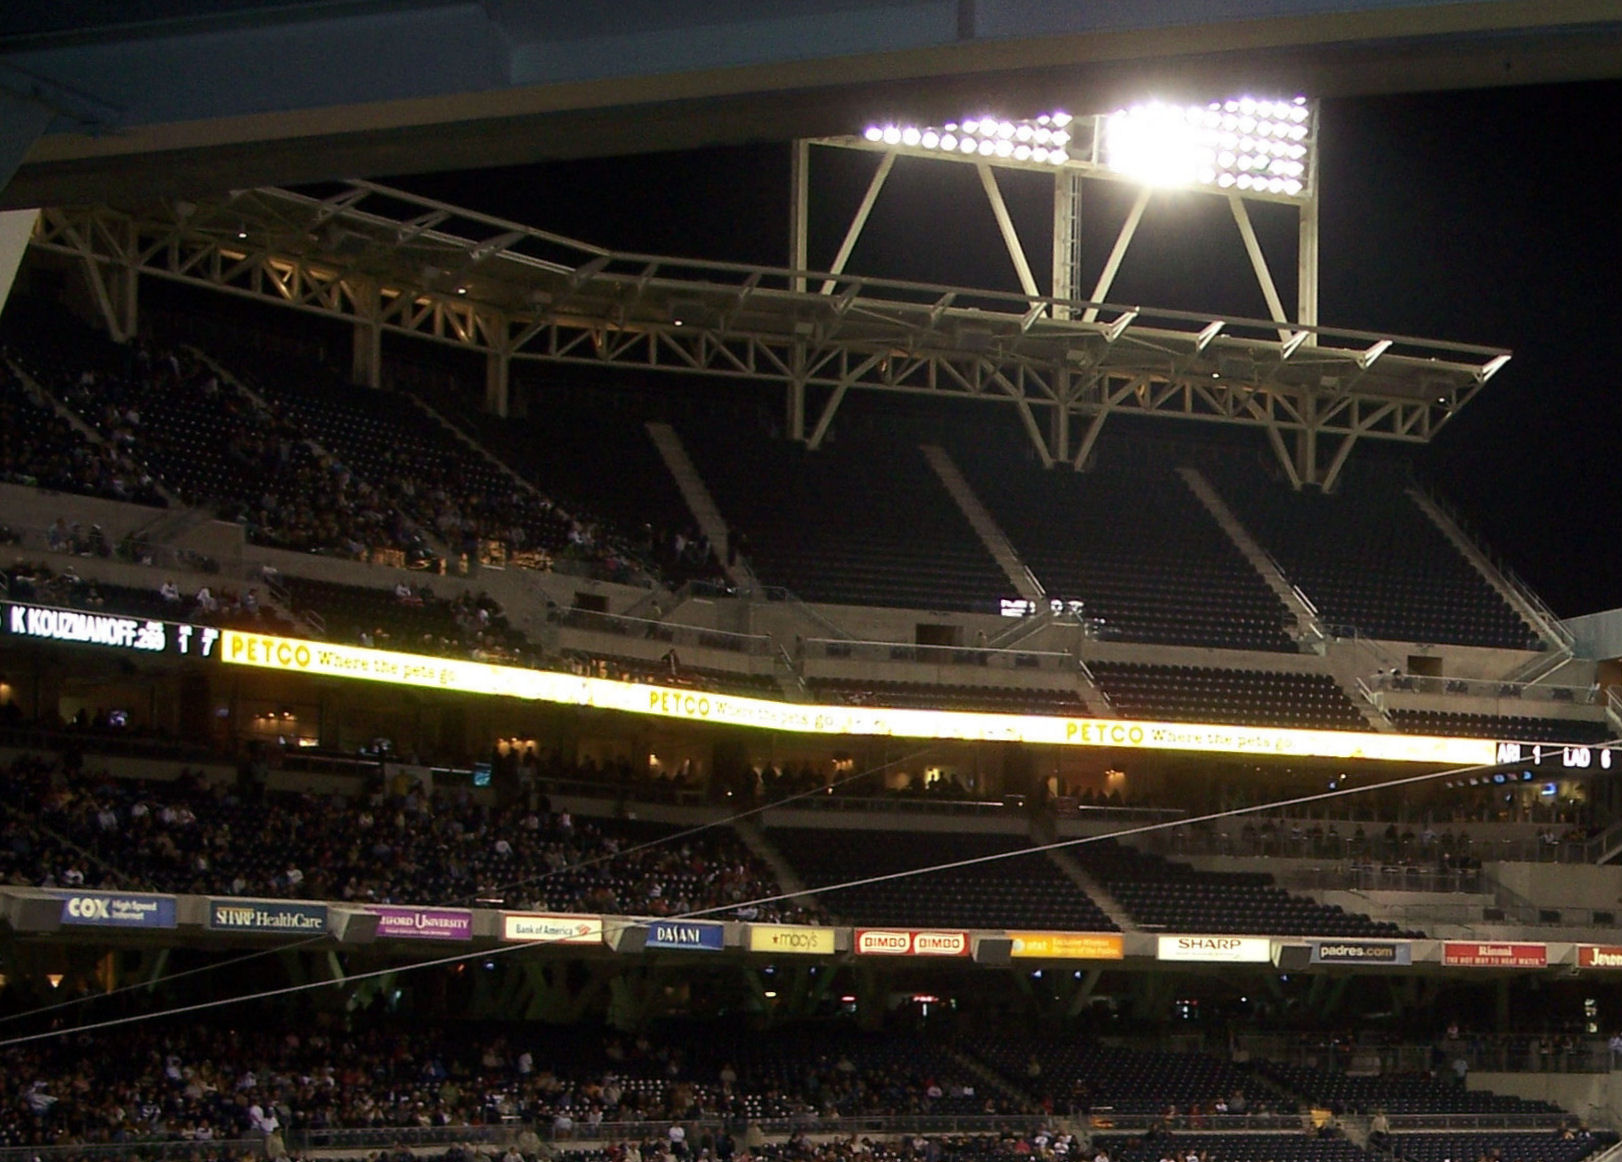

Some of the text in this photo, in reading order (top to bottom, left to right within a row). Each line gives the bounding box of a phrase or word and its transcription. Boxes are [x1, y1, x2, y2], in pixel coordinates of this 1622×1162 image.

[11, 605, 27, 634] K
[231, 635, 311, 668] PETCO
[649, 689, 711, 717] PETCO
[1066, 722, 1145, 745] PETCO
[68, 897, 110, 920] COX
[215, 909, 323, 930] SHARP HealthCare
[515, 923, 573, 937] Bank of America
[656, 925, 700, 944] DASANI
[864, 936, 961, 949] BIMBO BIMBO
[1178, 938, 1242, 950] SHARP
[1320, 944, 1393, 960] padres.com
